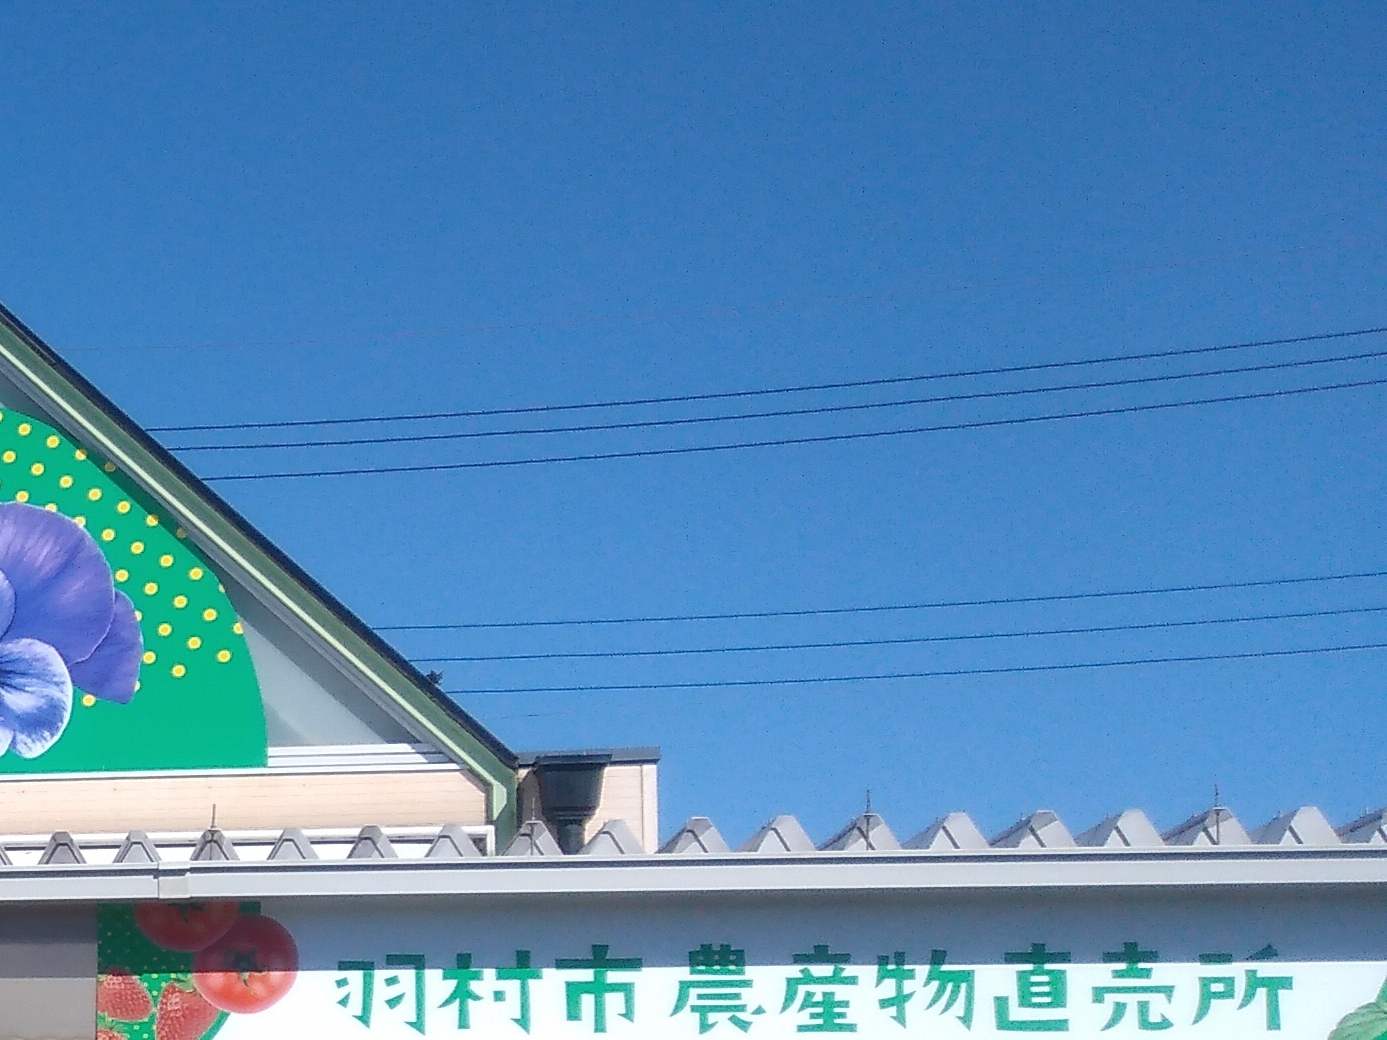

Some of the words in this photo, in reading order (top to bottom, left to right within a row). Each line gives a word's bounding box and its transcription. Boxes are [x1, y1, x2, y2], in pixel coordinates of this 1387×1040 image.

[335, 941, 1294, 1036] 羽村市農産物直売所
